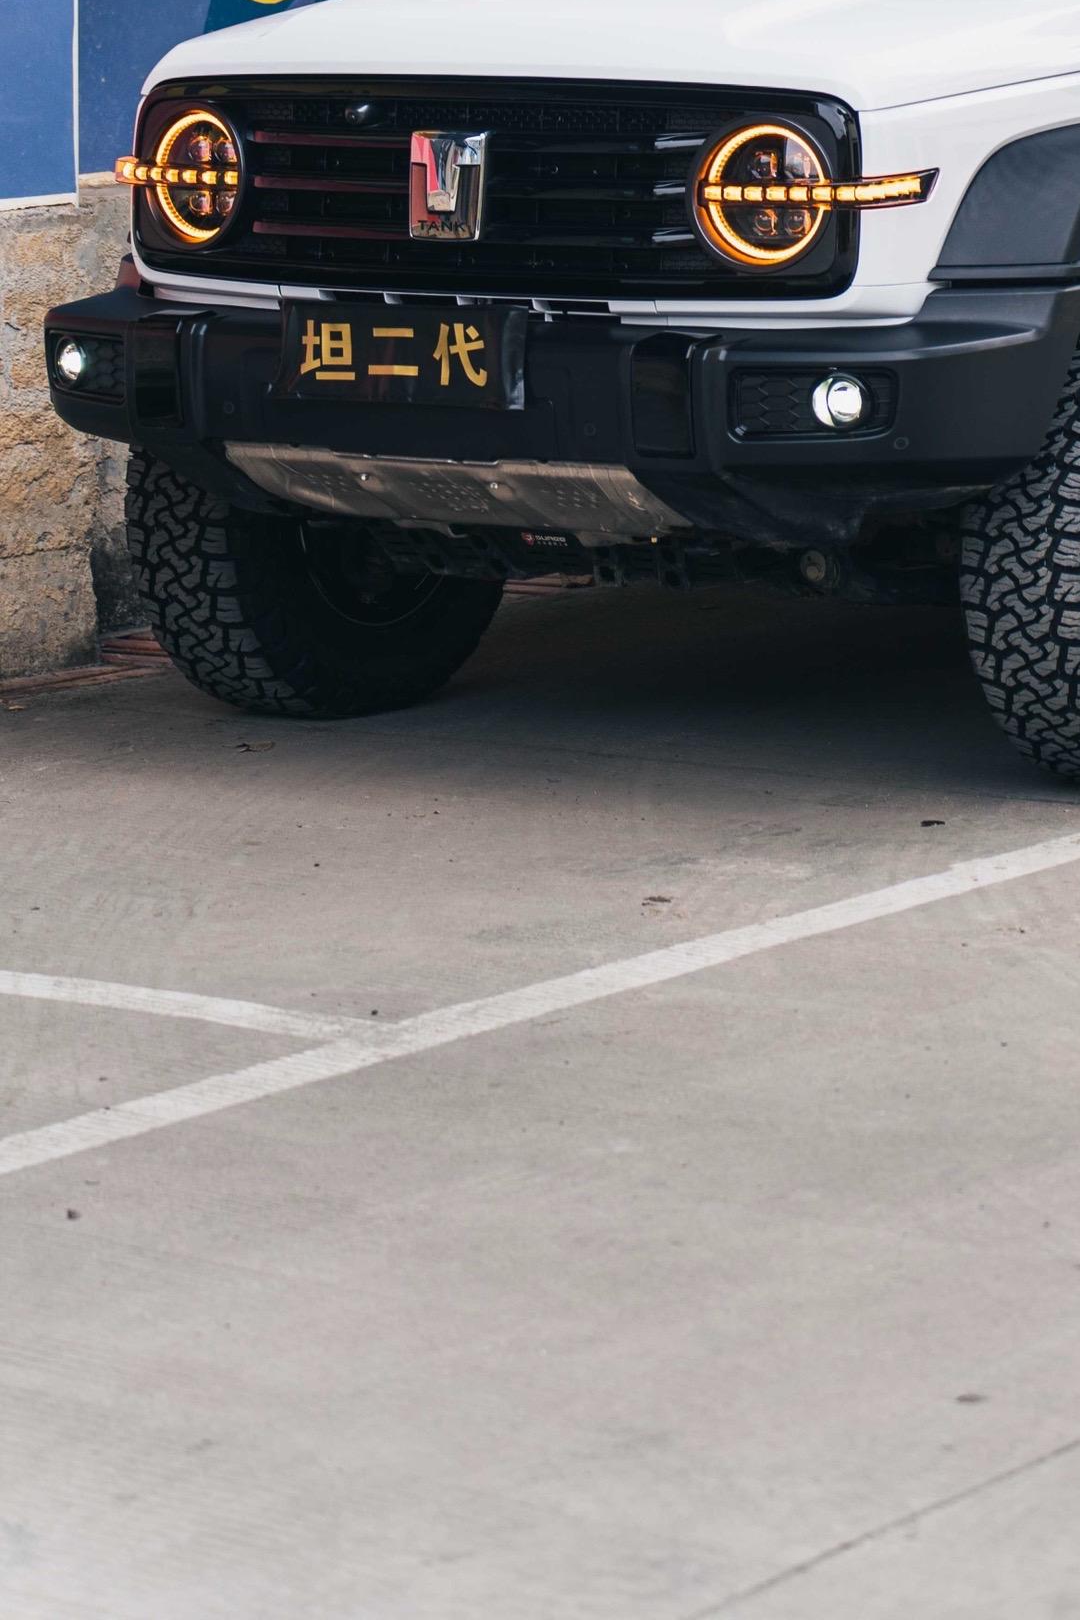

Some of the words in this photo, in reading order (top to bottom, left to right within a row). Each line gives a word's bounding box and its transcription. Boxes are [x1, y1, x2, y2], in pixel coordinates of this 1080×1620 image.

[418, 220, 466, 232] TANK
[301, 319, 488, 387] 坦二代
